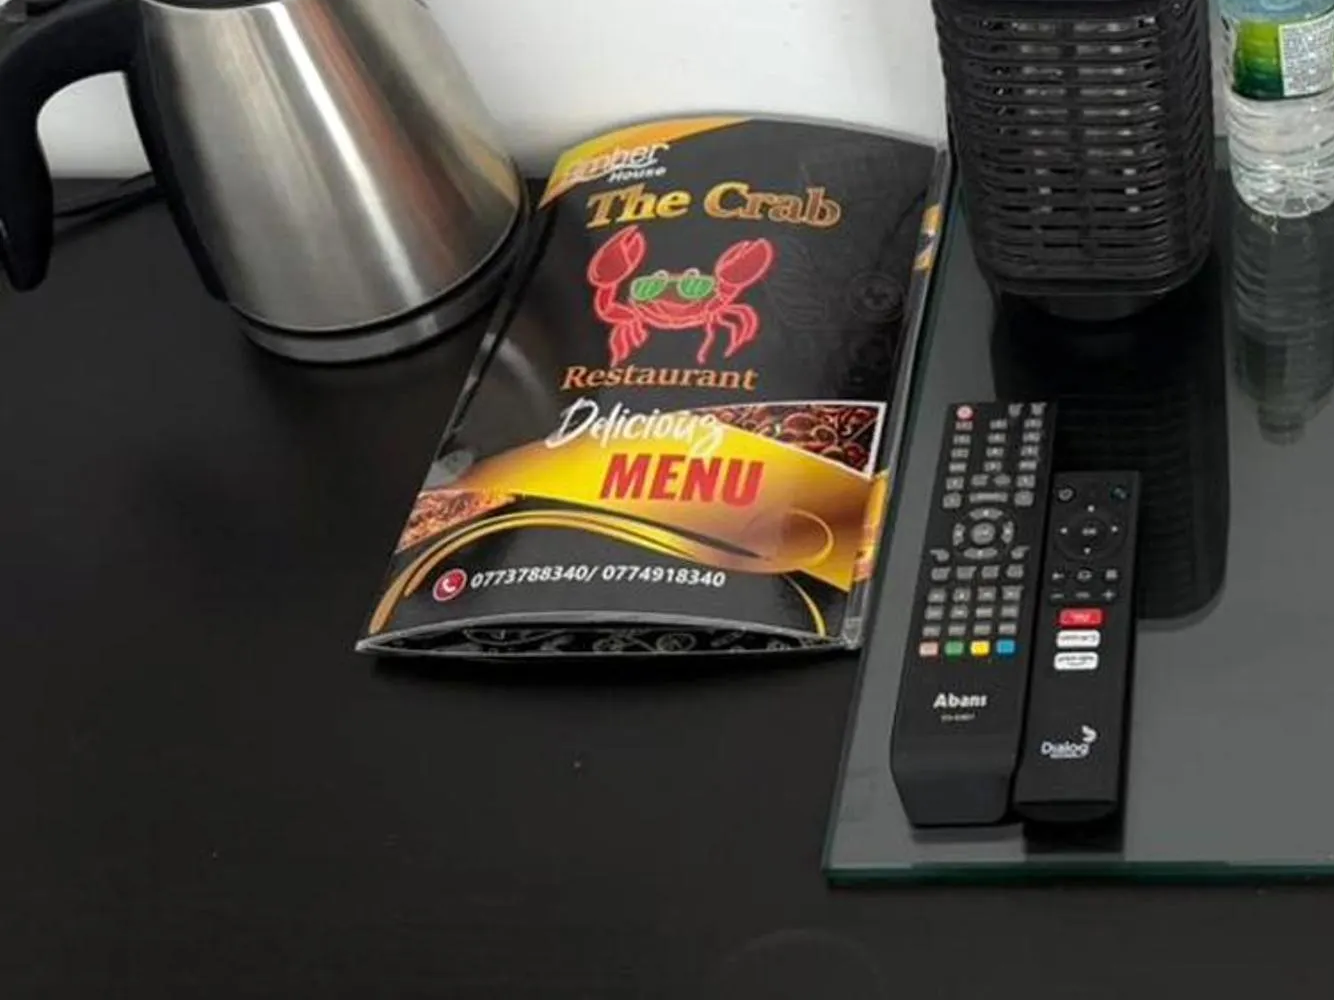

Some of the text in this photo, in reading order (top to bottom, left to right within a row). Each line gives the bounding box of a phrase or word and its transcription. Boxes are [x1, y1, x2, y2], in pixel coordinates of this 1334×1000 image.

[586, 180, 842, 229] The Crab
[560, 363, 758, 392] Restaurant
[545, 397, 727, 460] Delicious
[599, 453, 764, 507] MENU
[470, 563, 726, 589] 0773788340/ 0774918340
